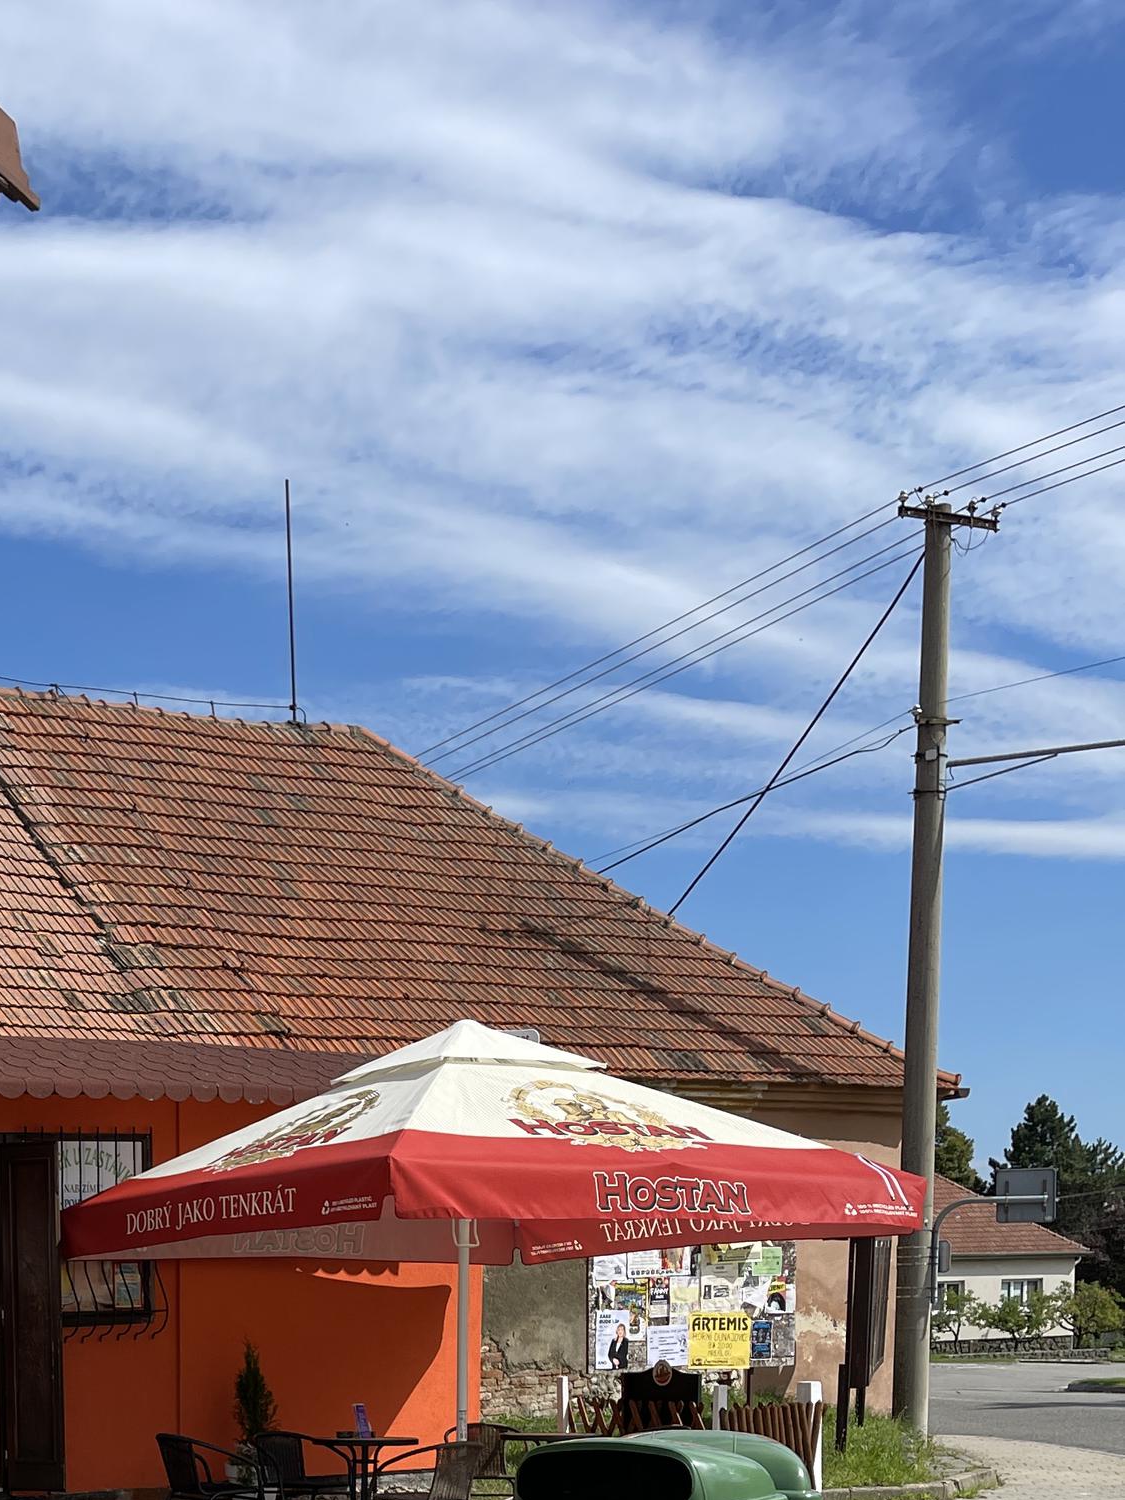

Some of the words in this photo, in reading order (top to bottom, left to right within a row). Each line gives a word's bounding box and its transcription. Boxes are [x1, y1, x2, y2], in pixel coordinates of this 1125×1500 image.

[509, 1118, 716, 1142] HOSTAN
[125, 1200, 173, 1235] DOBRÝ
[175, 1196, 216, 1231] JAKO
[218, 1183, 298, 1220] TENKRÁT
[592, 1171, 752, 1215] HOSTAN
[692, 1317, 749, 1332] ARTEMIS
